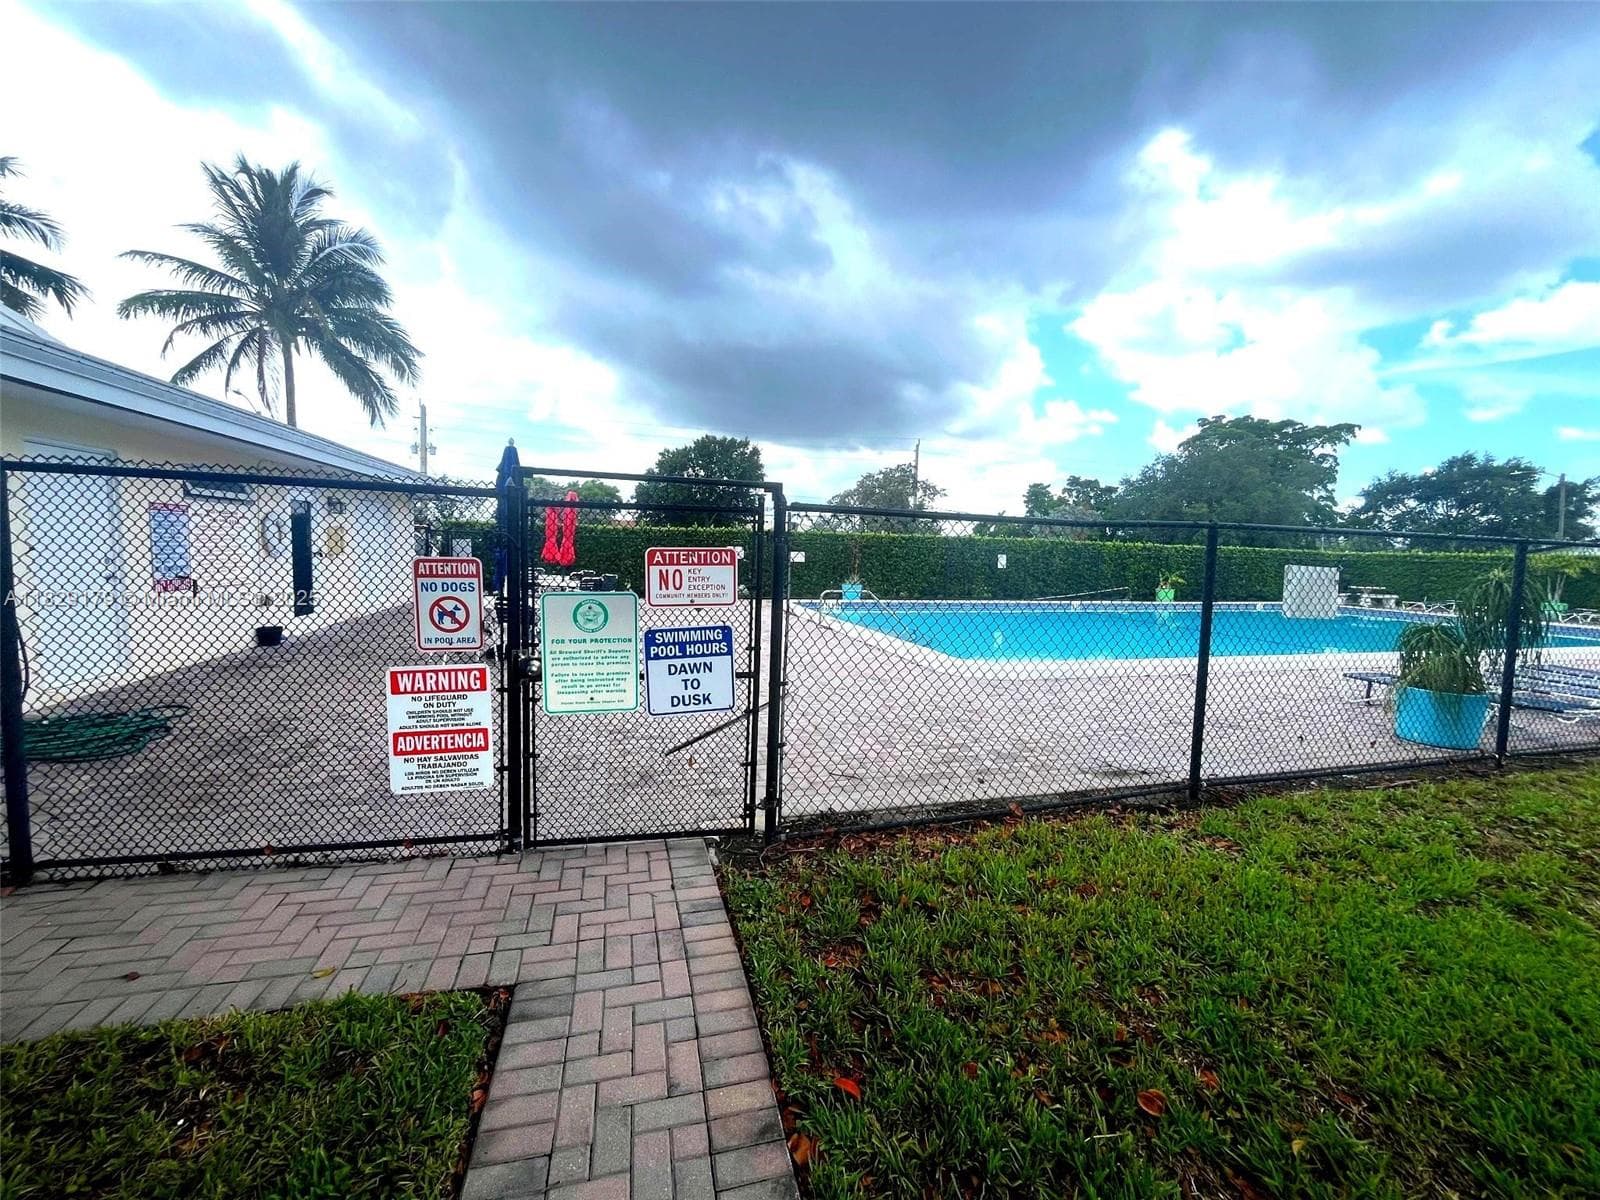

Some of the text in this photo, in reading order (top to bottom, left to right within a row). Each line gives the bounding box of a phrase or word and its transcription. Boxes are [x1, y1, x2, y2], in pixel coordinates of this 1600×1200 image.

[653, 552, 730, 564] ATTENTION
[418, 562, 476, 574] ATTENTION
[420, 582, 476, 592] NO DOGS
[658, 569, 683, 591] NO
[655, 629, 722, 644] SWIMMING
[650, 642, 728, 658] POOL HOURS
[668, 662, 712, 676] DAWN
[396, 670, 480, 692] WARNING
[682, 678, 700, 690] TO
[671, 693, 712, 708] DUSK
[397, 732, 485, 752] ADVERTENCIA
[416, 761, 468, 770] TRABAJANDO
